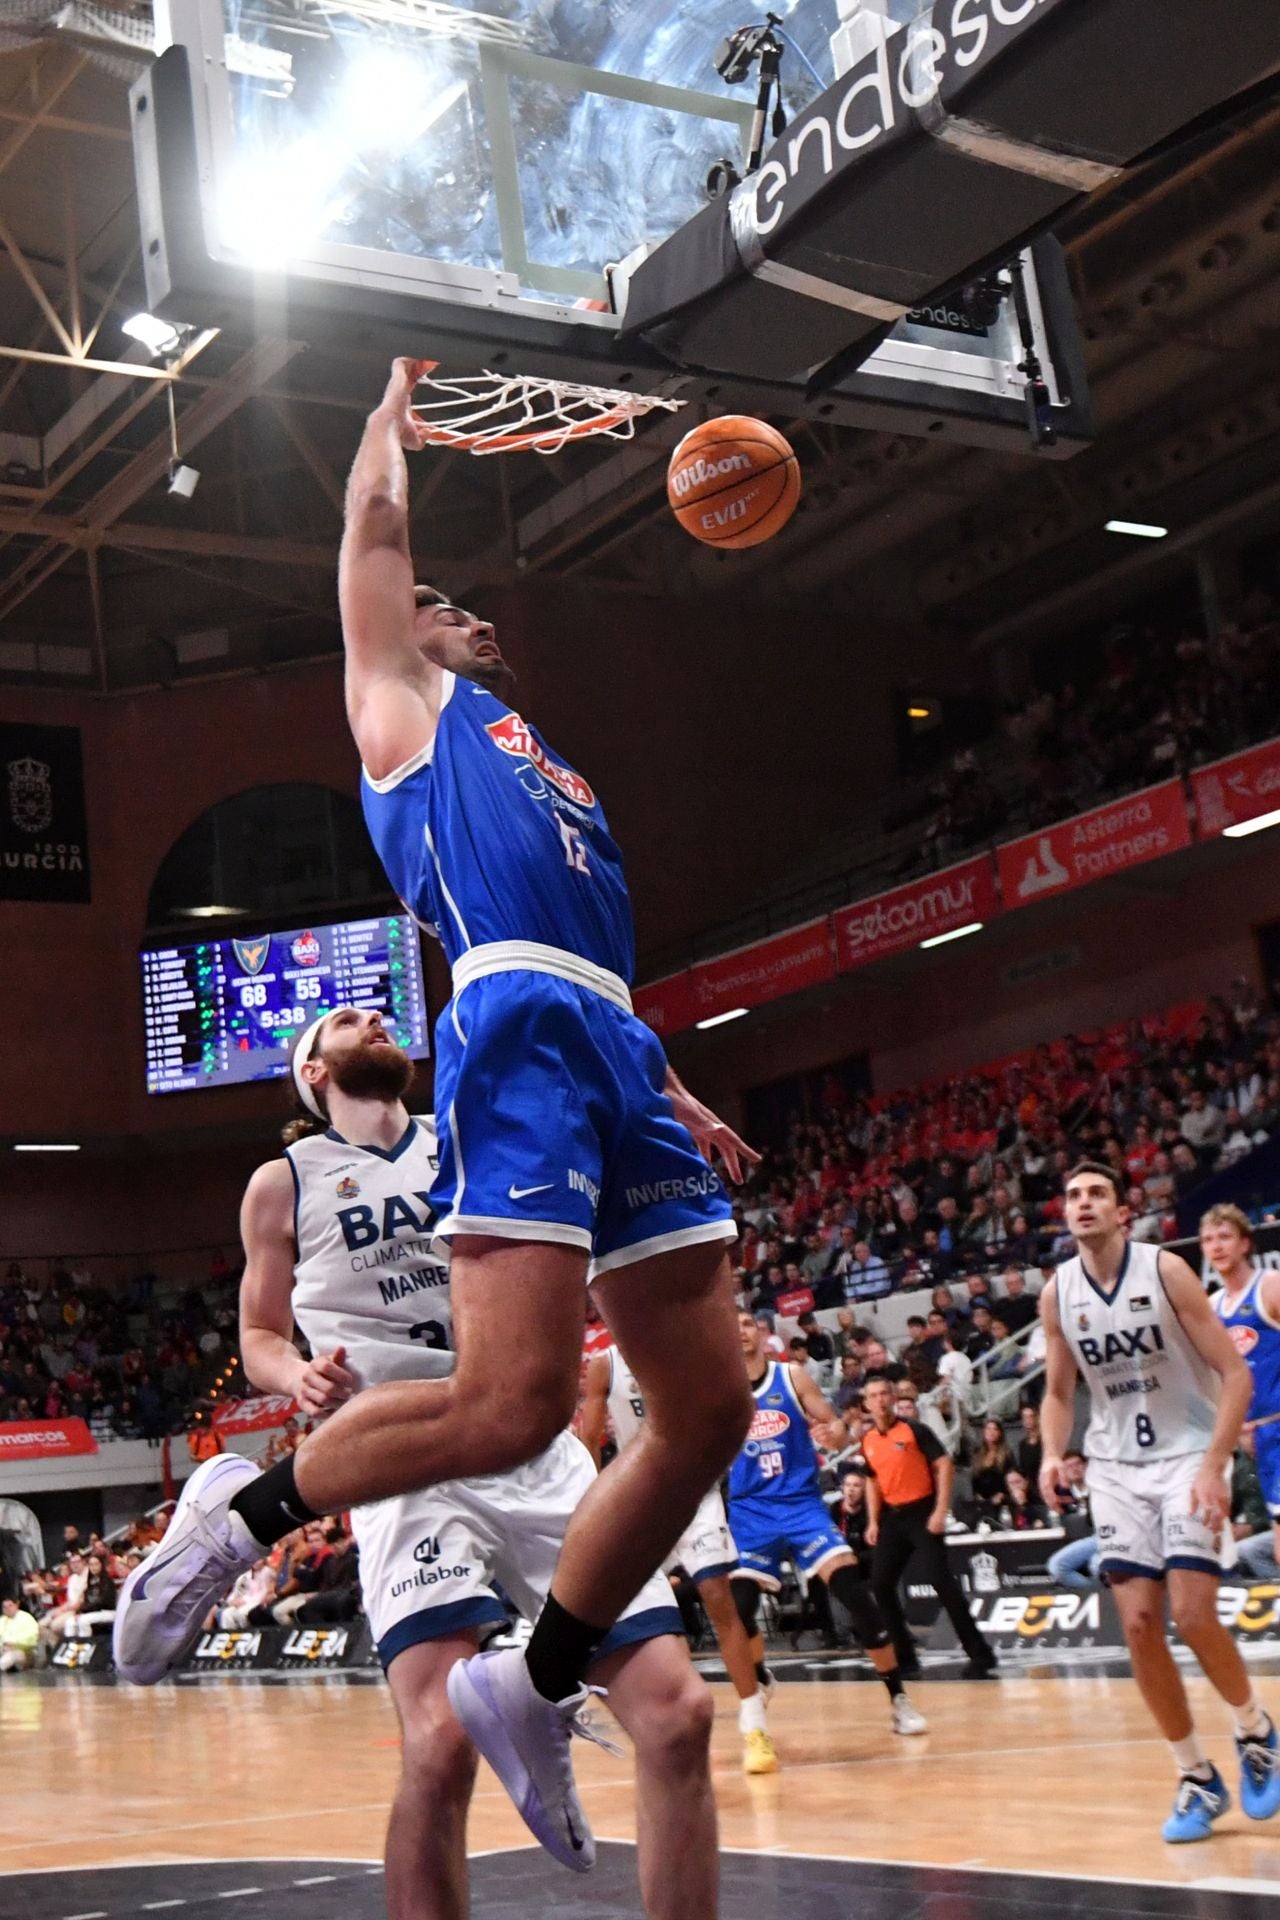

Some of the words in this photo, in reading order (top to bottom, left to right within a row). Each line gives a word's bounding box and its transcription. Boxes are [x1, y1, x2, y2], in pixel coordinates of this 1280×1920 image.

[671, 453, 752, 497] Wilson
[3, 851, 84, 871] URCIA
[1074, 826, 1169, 877] Partners
[847, 876, 976, 947] setcomur
[241, 984, 267, 1008] 68
[295, 976, 321, 1001] 55
[260, 1006, 307, 1029] 5:38
[625, 1171, 720, 1208] INVERSUS
[336, 1191, 440, 1252] BAX
[351, 1239, 434, 1273] CLIMATIZ
[377, 1265, 449, 1306] MANRE
[1078, 1324, 1164, 1366] BAXI
[746, 1421, 788, 1438] URCIA
[1136, 1412, 1156, 1448] 8
[759, 1452, 783, 1479] 99
[391, 1565, 471, 1597] unilabor
